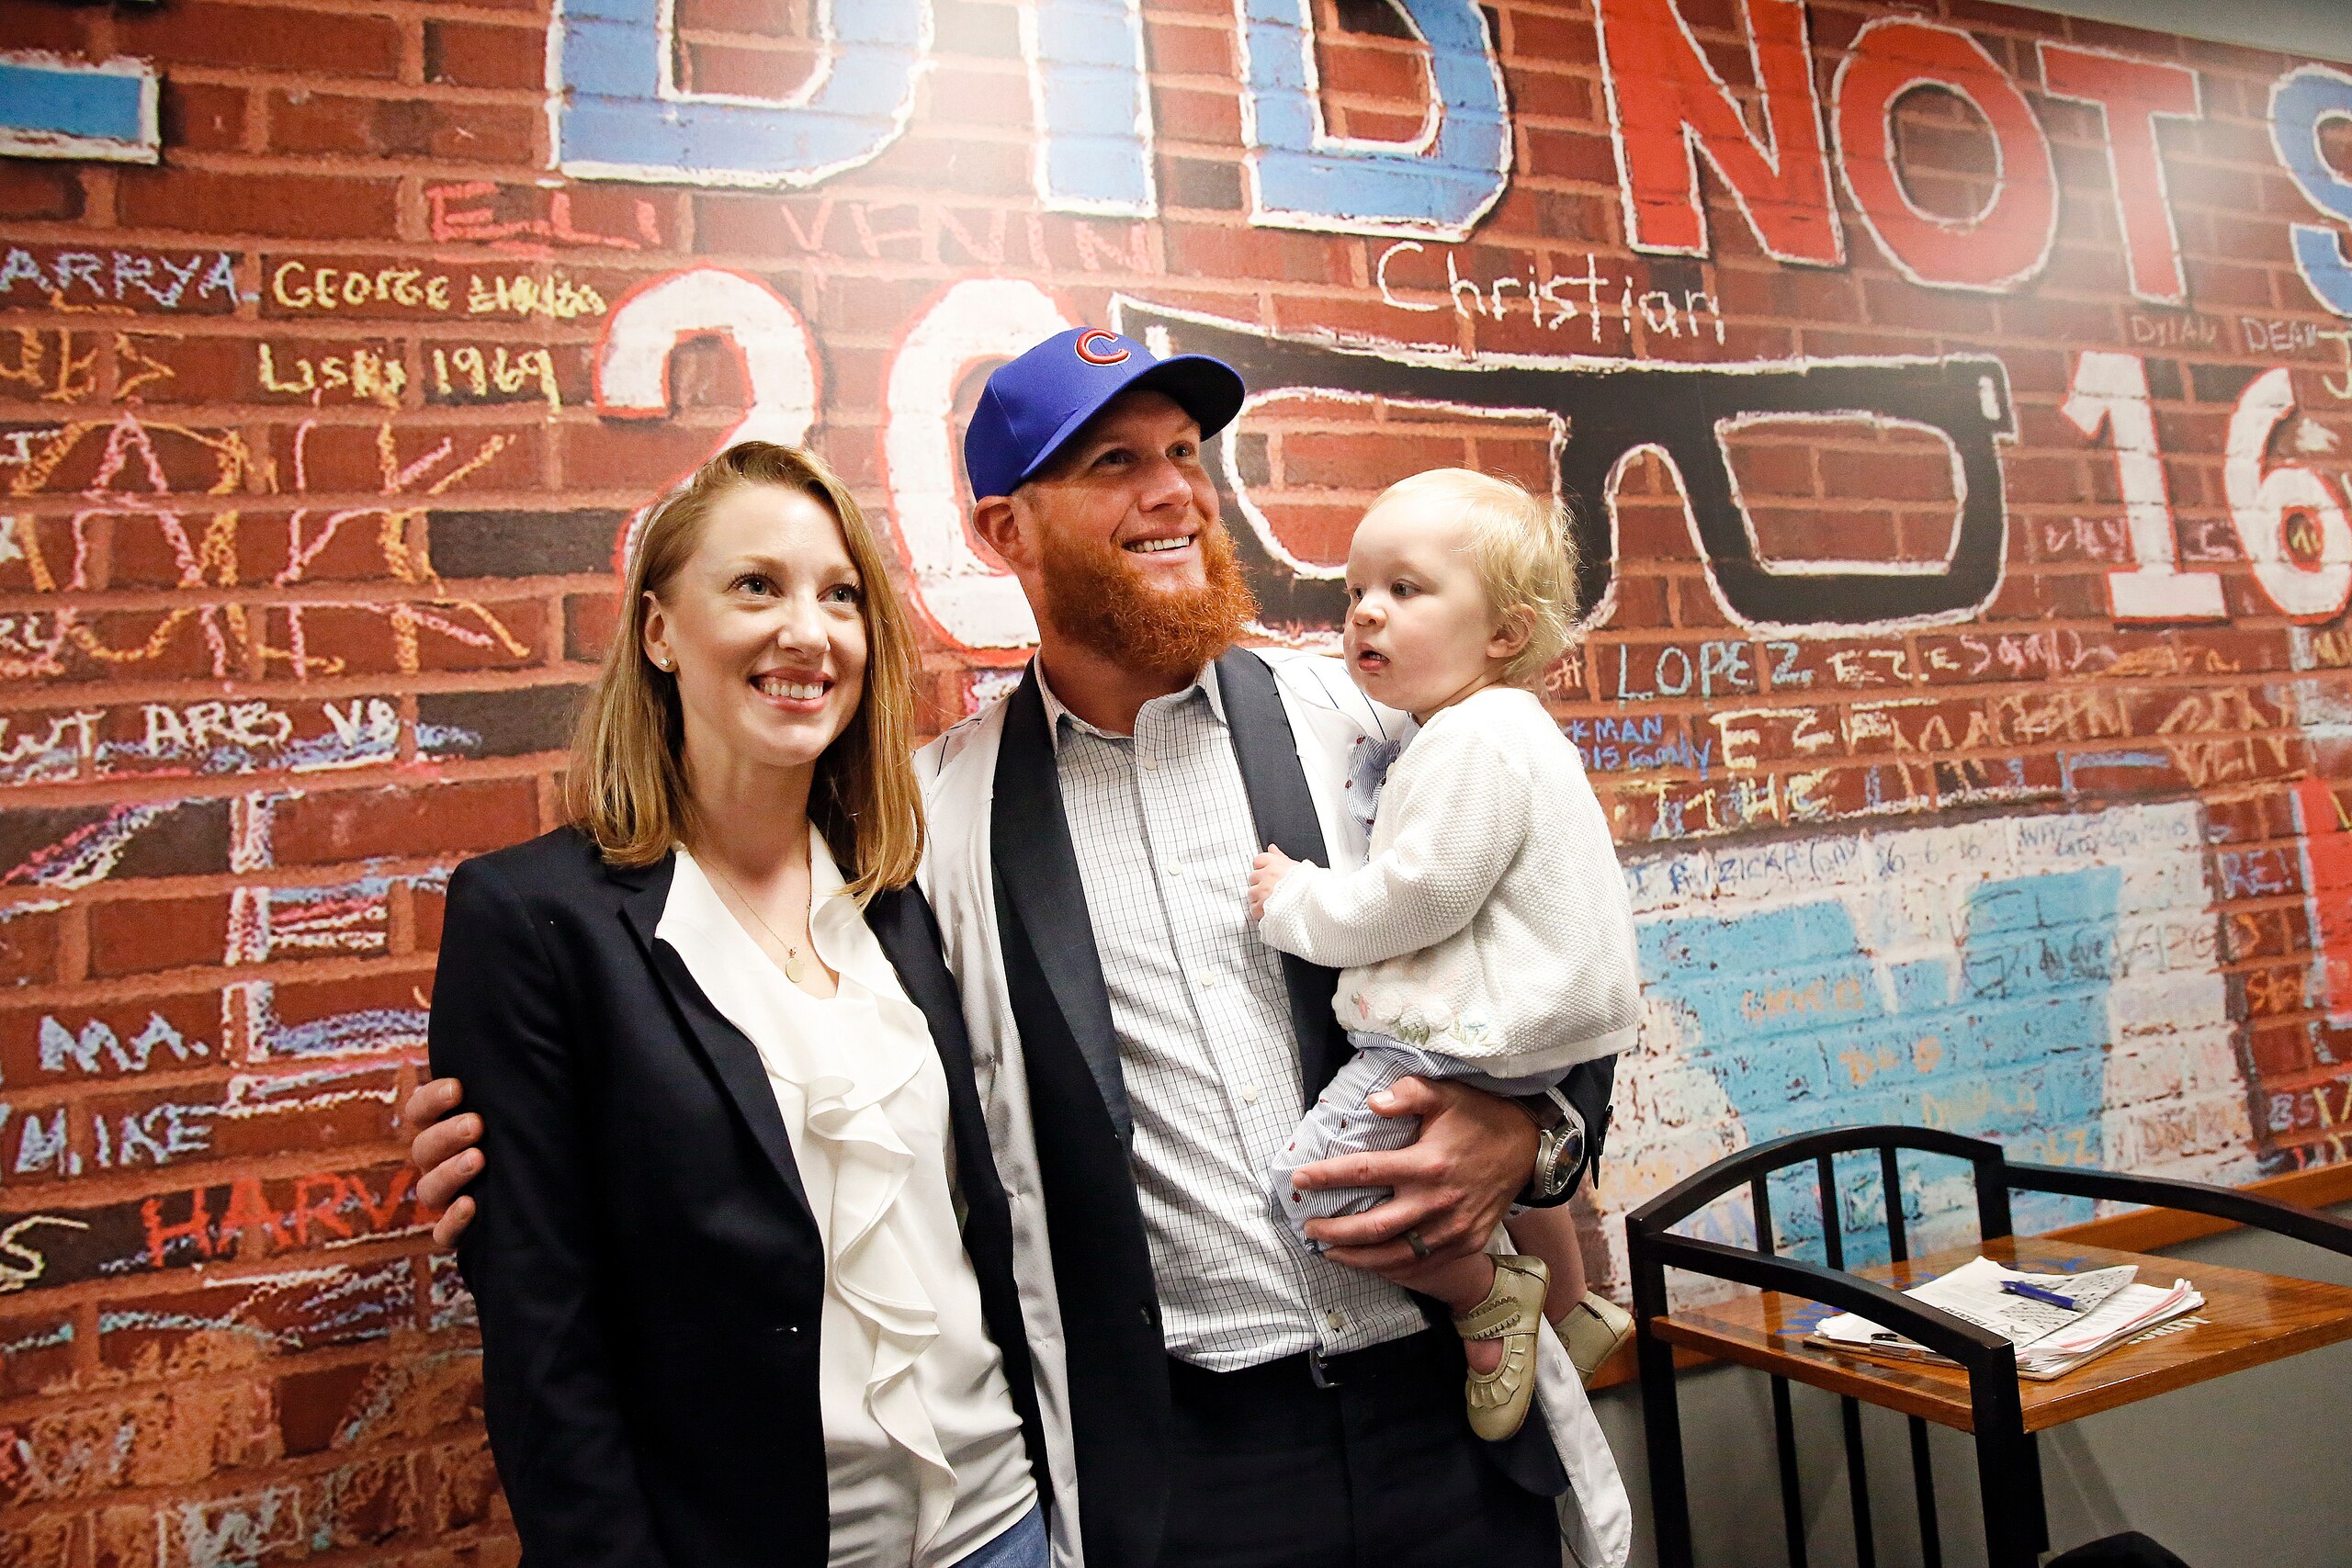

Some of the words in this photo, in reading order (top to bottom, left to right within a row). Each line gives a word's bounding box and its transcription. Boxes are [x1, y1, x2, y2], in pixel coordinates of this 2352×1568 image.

[1597, 0, 2203, 308] NOT
[1377, 241, 1726, 345] Christian
[432, 346, 562, 413] 1969
[1074, 327, 1132, 367] C
[2061, 351, 2352, 627] 16
[1618, 640, 1814, 698] LOPEZ
[2127, 1314, 2212, 1346] URITY
